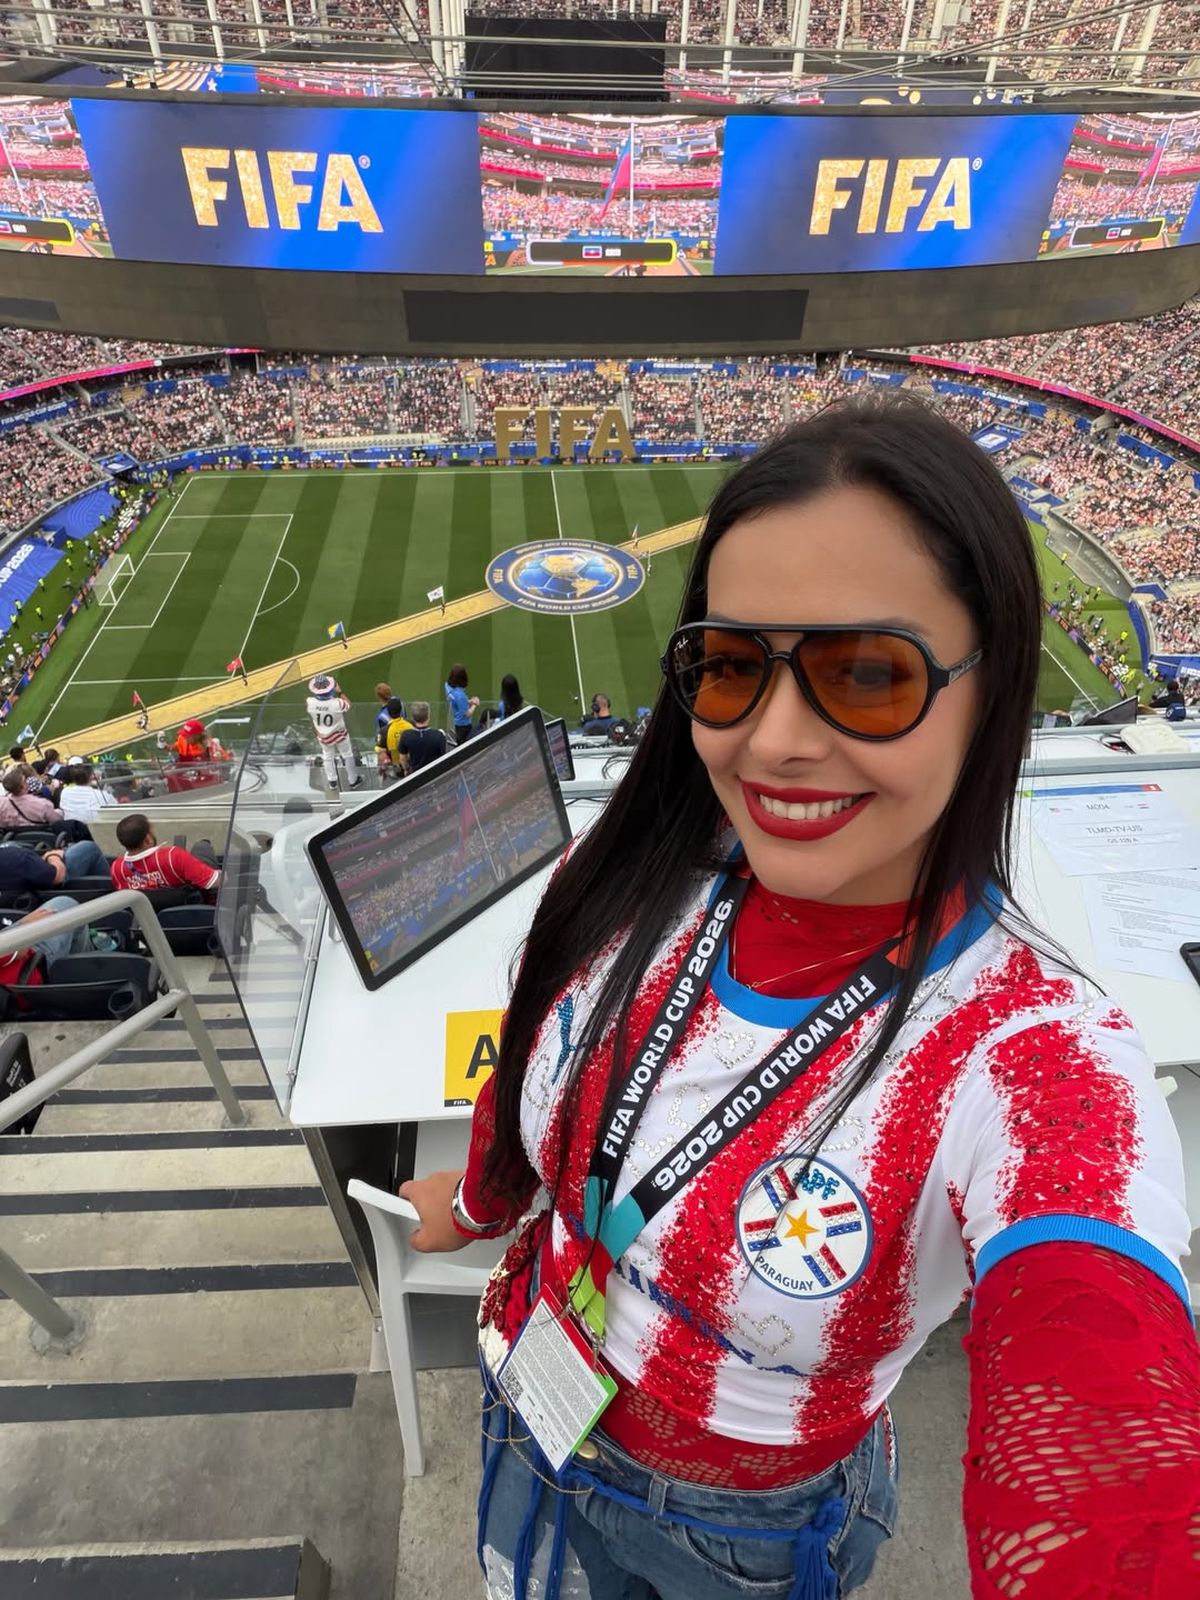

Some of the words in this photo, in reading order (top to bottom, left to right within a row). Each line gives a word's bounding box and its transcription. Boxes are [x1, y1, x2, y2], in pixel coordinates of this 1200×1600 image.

[494, 406, 636, 458] FIFA
[316, 713, 333, 727] 10
[824, 975, 877, 1021] FIFA
[465, 1034, 500, 1079] A
[602, 1108, 635, 1158] FIFA
[623, 1023, 673, 1104] WORLD
[666, 977, 695, 1022] CUP
[758, 1017, 834, 1089] WORLD
[723, 1085, 762, 1128] CUP
[755, 1255, 815, 1292] PARAGUAY
